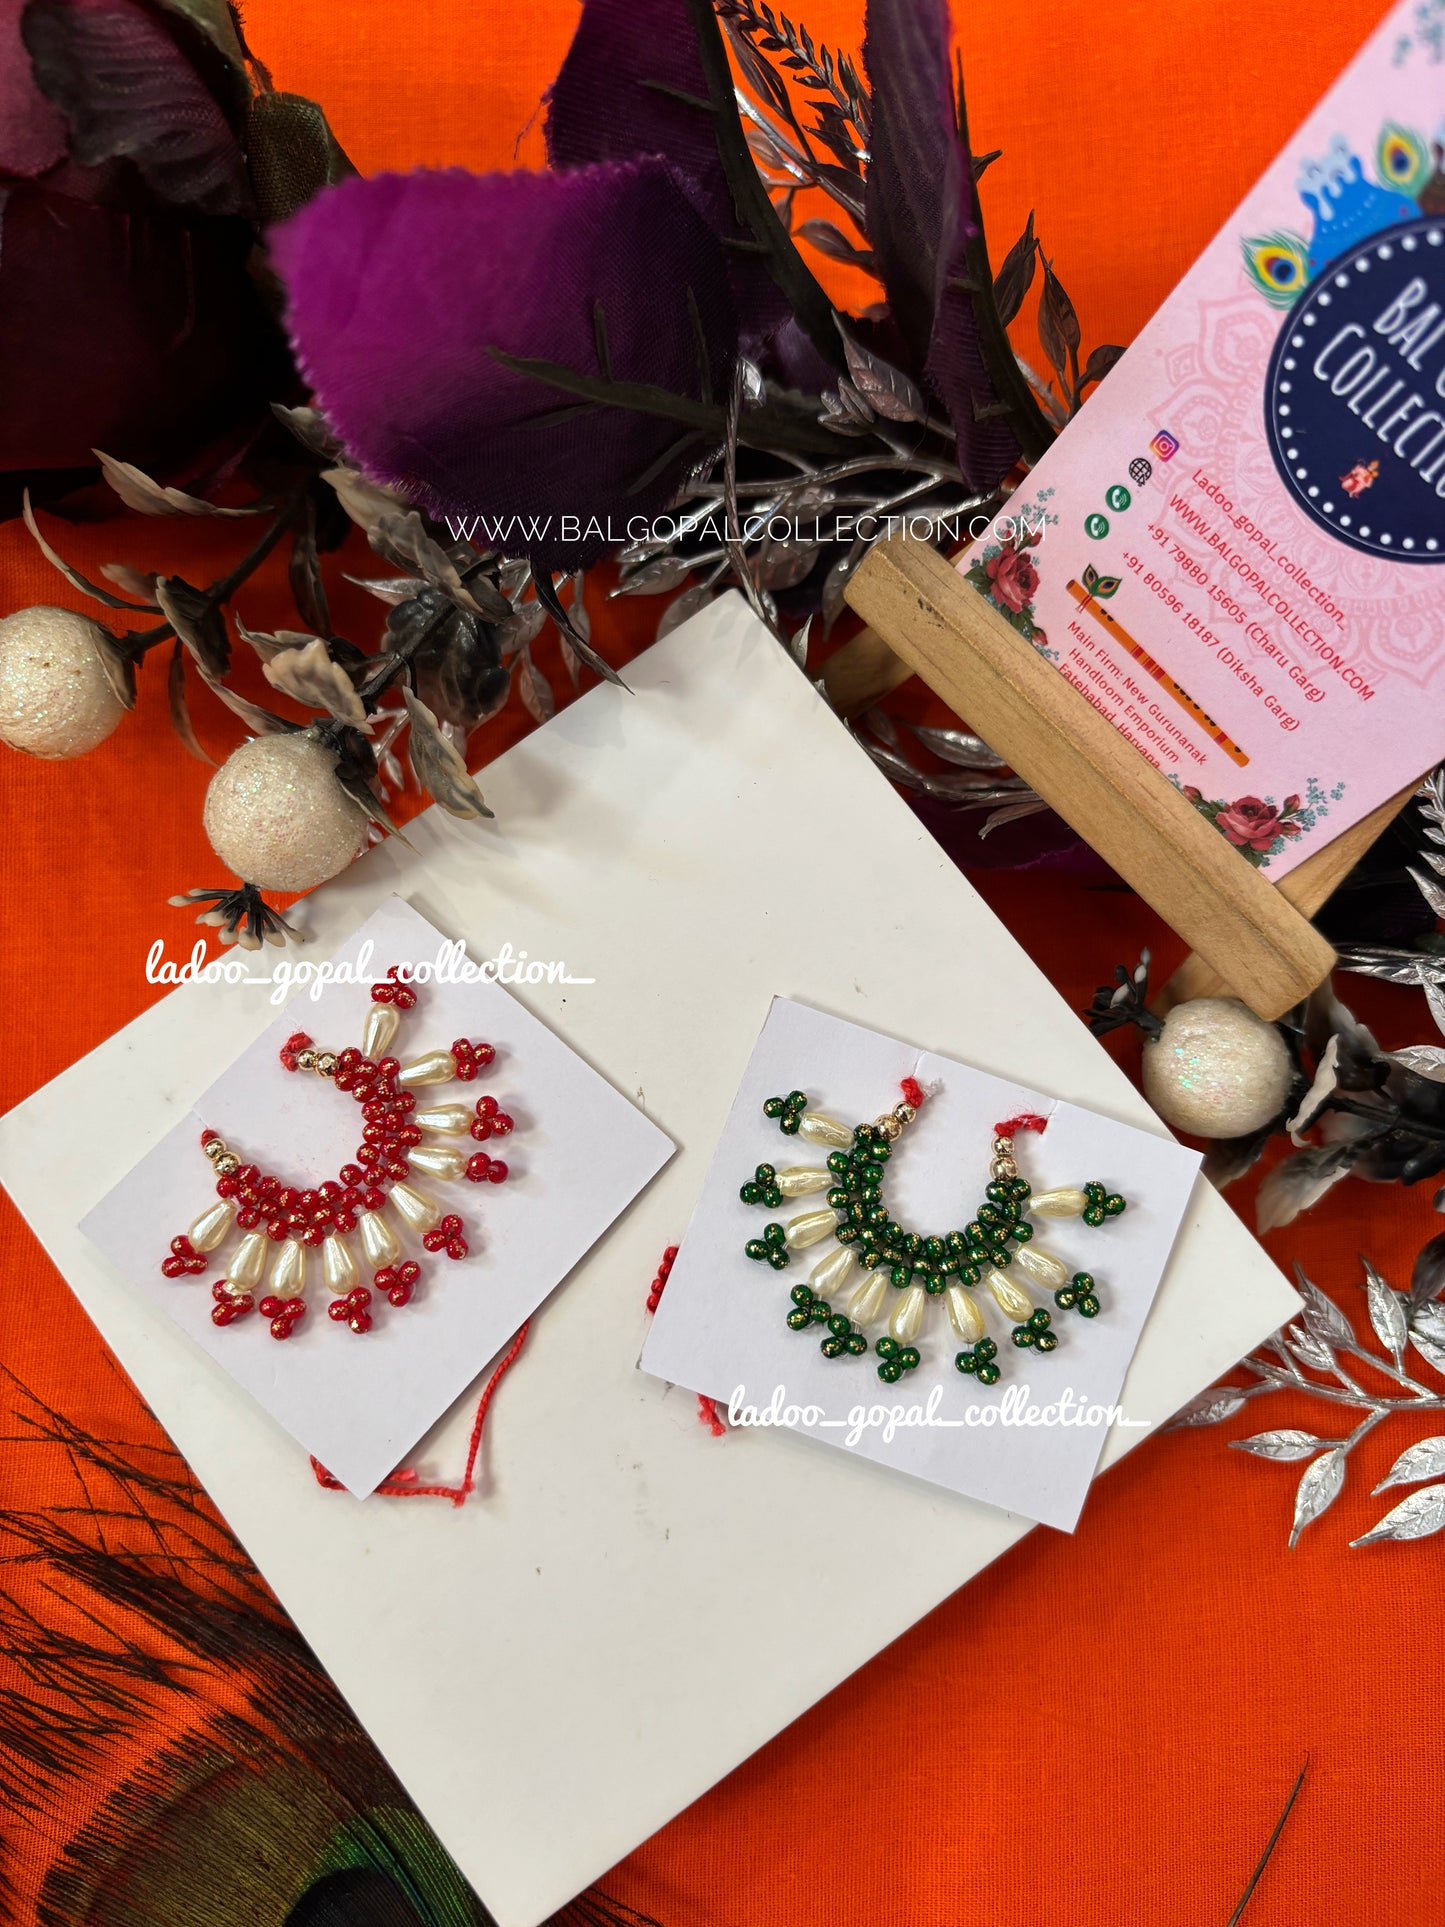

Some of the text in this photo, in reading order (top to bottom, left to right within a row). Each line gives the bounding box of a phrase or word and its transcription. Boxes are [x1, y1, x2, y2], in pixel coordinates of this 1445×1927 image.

[1372, 276, 1445, 372] BAL
[1147, 524, 1327, 703] +91 79880 15605 (Charu Garg)
[1169, 494, 1375, 702] WWW.BALGOPALCOLLECTION.COM
[1191, 469, 1346, 631] Ladoo_gopal_collection_
[1067, 621, 1208, 765] Main Firm: New Gurunanak
[1068, 648, 1180, 763] Handloom Emporium
[1122, 552, 1301, 732] +91 80596 18187 (Diksha Garg)
